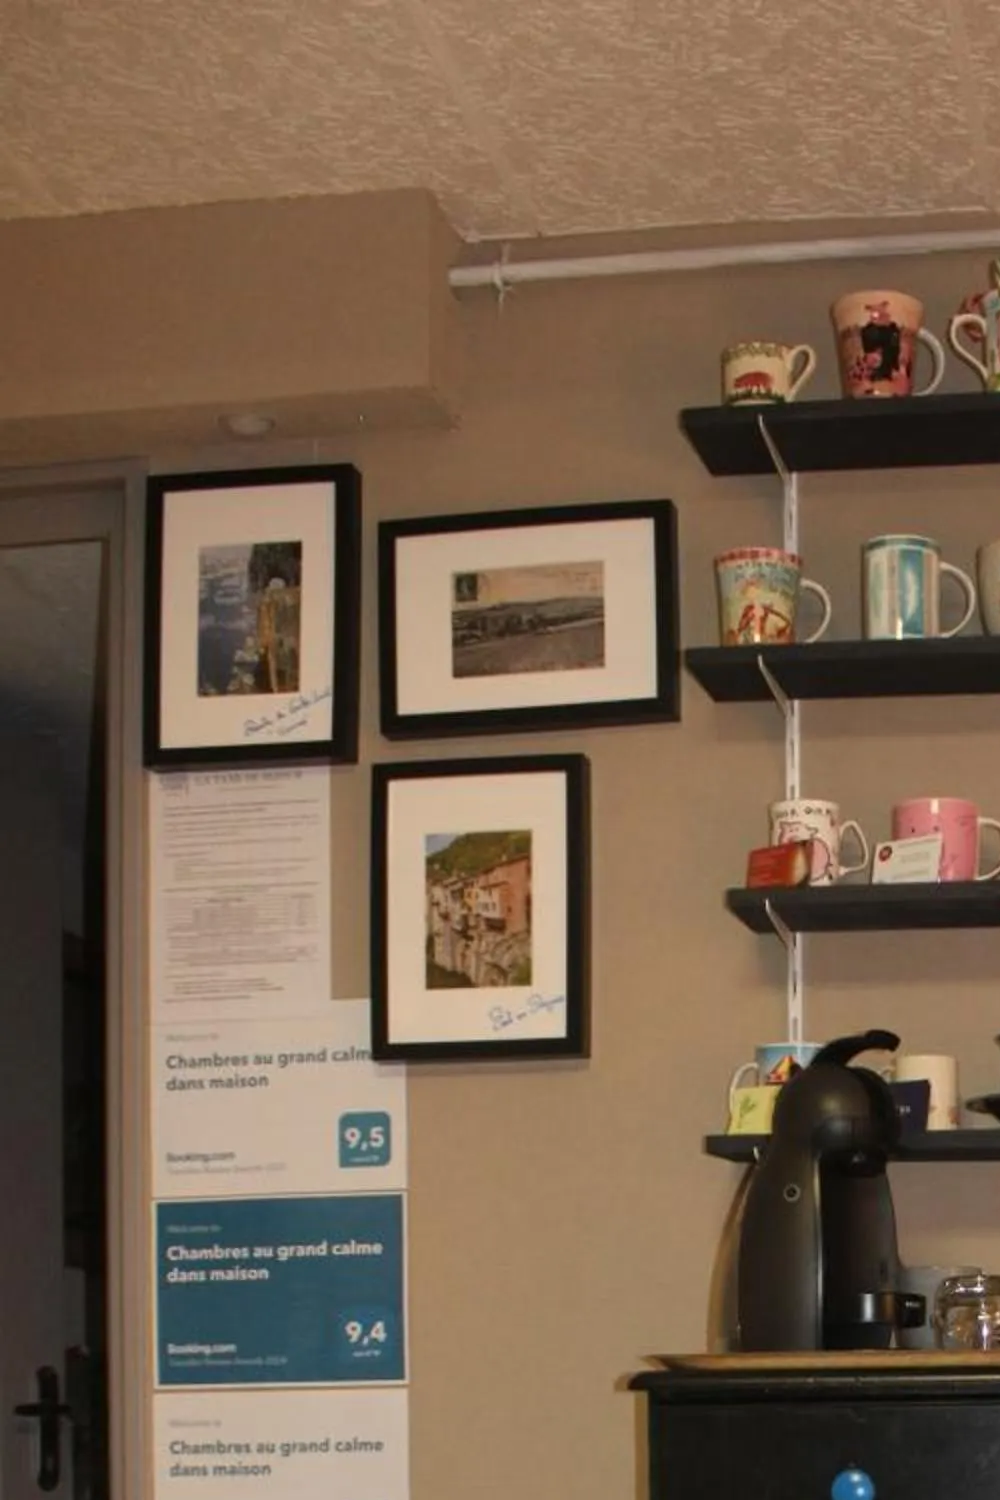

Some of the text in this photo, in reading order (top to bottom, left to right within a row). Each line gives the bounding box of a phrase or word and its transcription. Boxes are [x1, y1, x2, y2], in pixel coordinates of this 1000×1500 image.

[166, 1046, 373, 1070] Chambres au grand calm
[166, 1074, 269, 1091] dans maison
[344, 1125, 385, 1151] 9,5
[166, 1240, 383, 1261] Chambres au grand calme
[166, 1265, 269, 1283] dans maison
[345, 1320, 387, 1346] 9,4
[169, 1437, 384, 1457] Chambres au grand calme
[169, 1461, 272, 1477] dans maison
